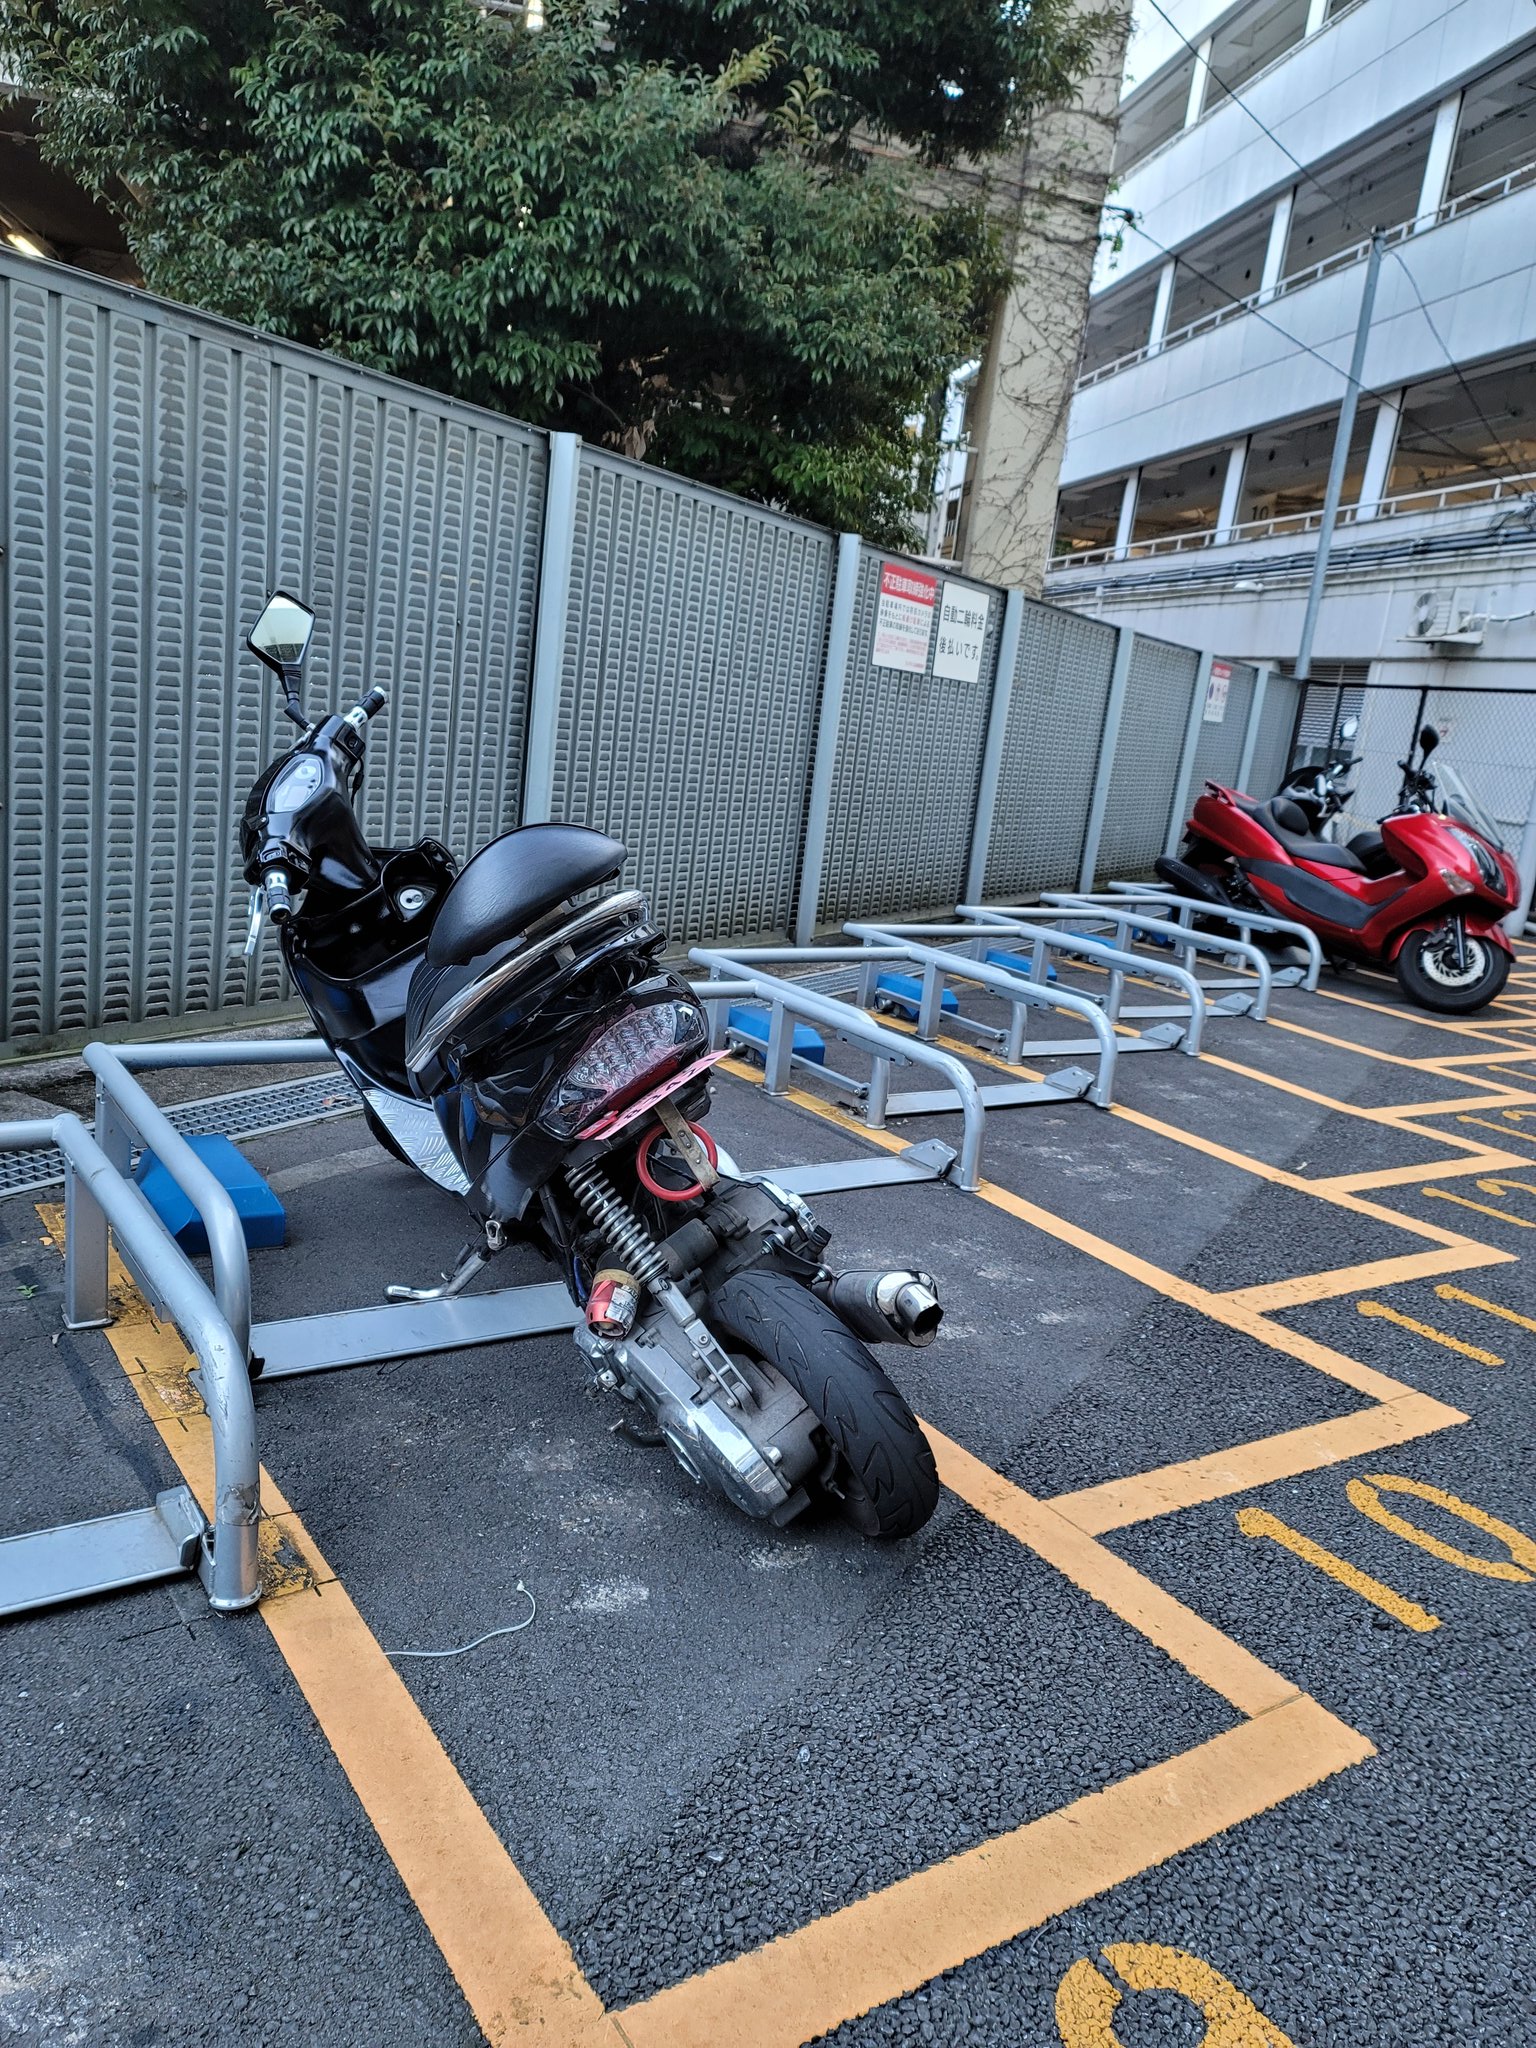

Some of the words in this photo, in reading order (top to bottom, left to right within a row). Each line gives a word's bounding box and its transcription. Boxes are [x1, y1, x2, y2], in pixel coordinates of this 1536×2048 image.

[1252, 505, 1269, 520] 10
[943, 603, 984, 631] 自動二輪料金
[1357, 1283, 1536, 1367] 11
[1236, 1473, 1536, 1633] 10
